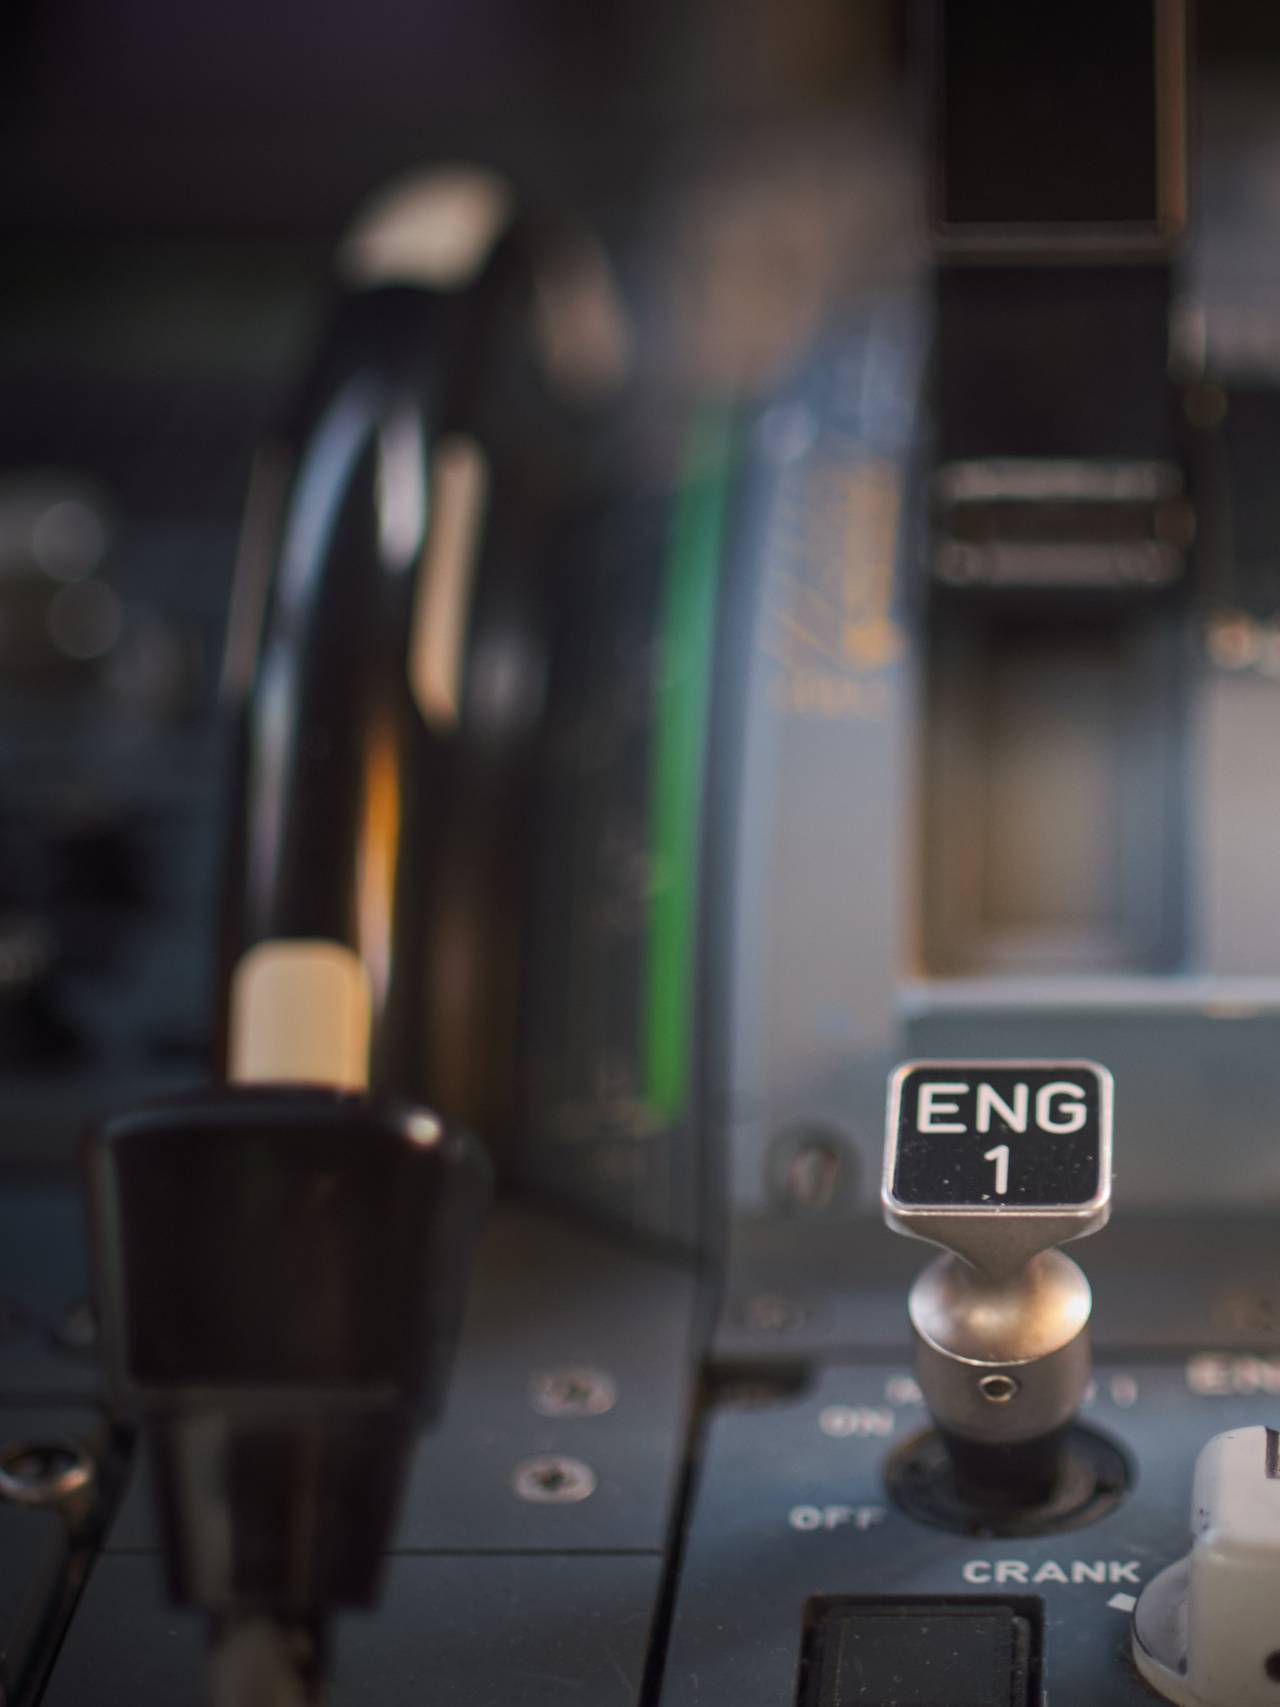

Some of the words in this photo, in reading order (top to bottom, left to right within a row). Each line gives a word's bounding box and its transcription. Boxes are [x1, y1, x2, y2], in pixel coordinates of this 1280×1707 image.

[917, 1082, 1088, 1134] ENG
[984, 1145, 1010, 1195] 1
[789, 1505, 882, 1531] OFF
[962, 1560, 1141, 1584] CRANK
